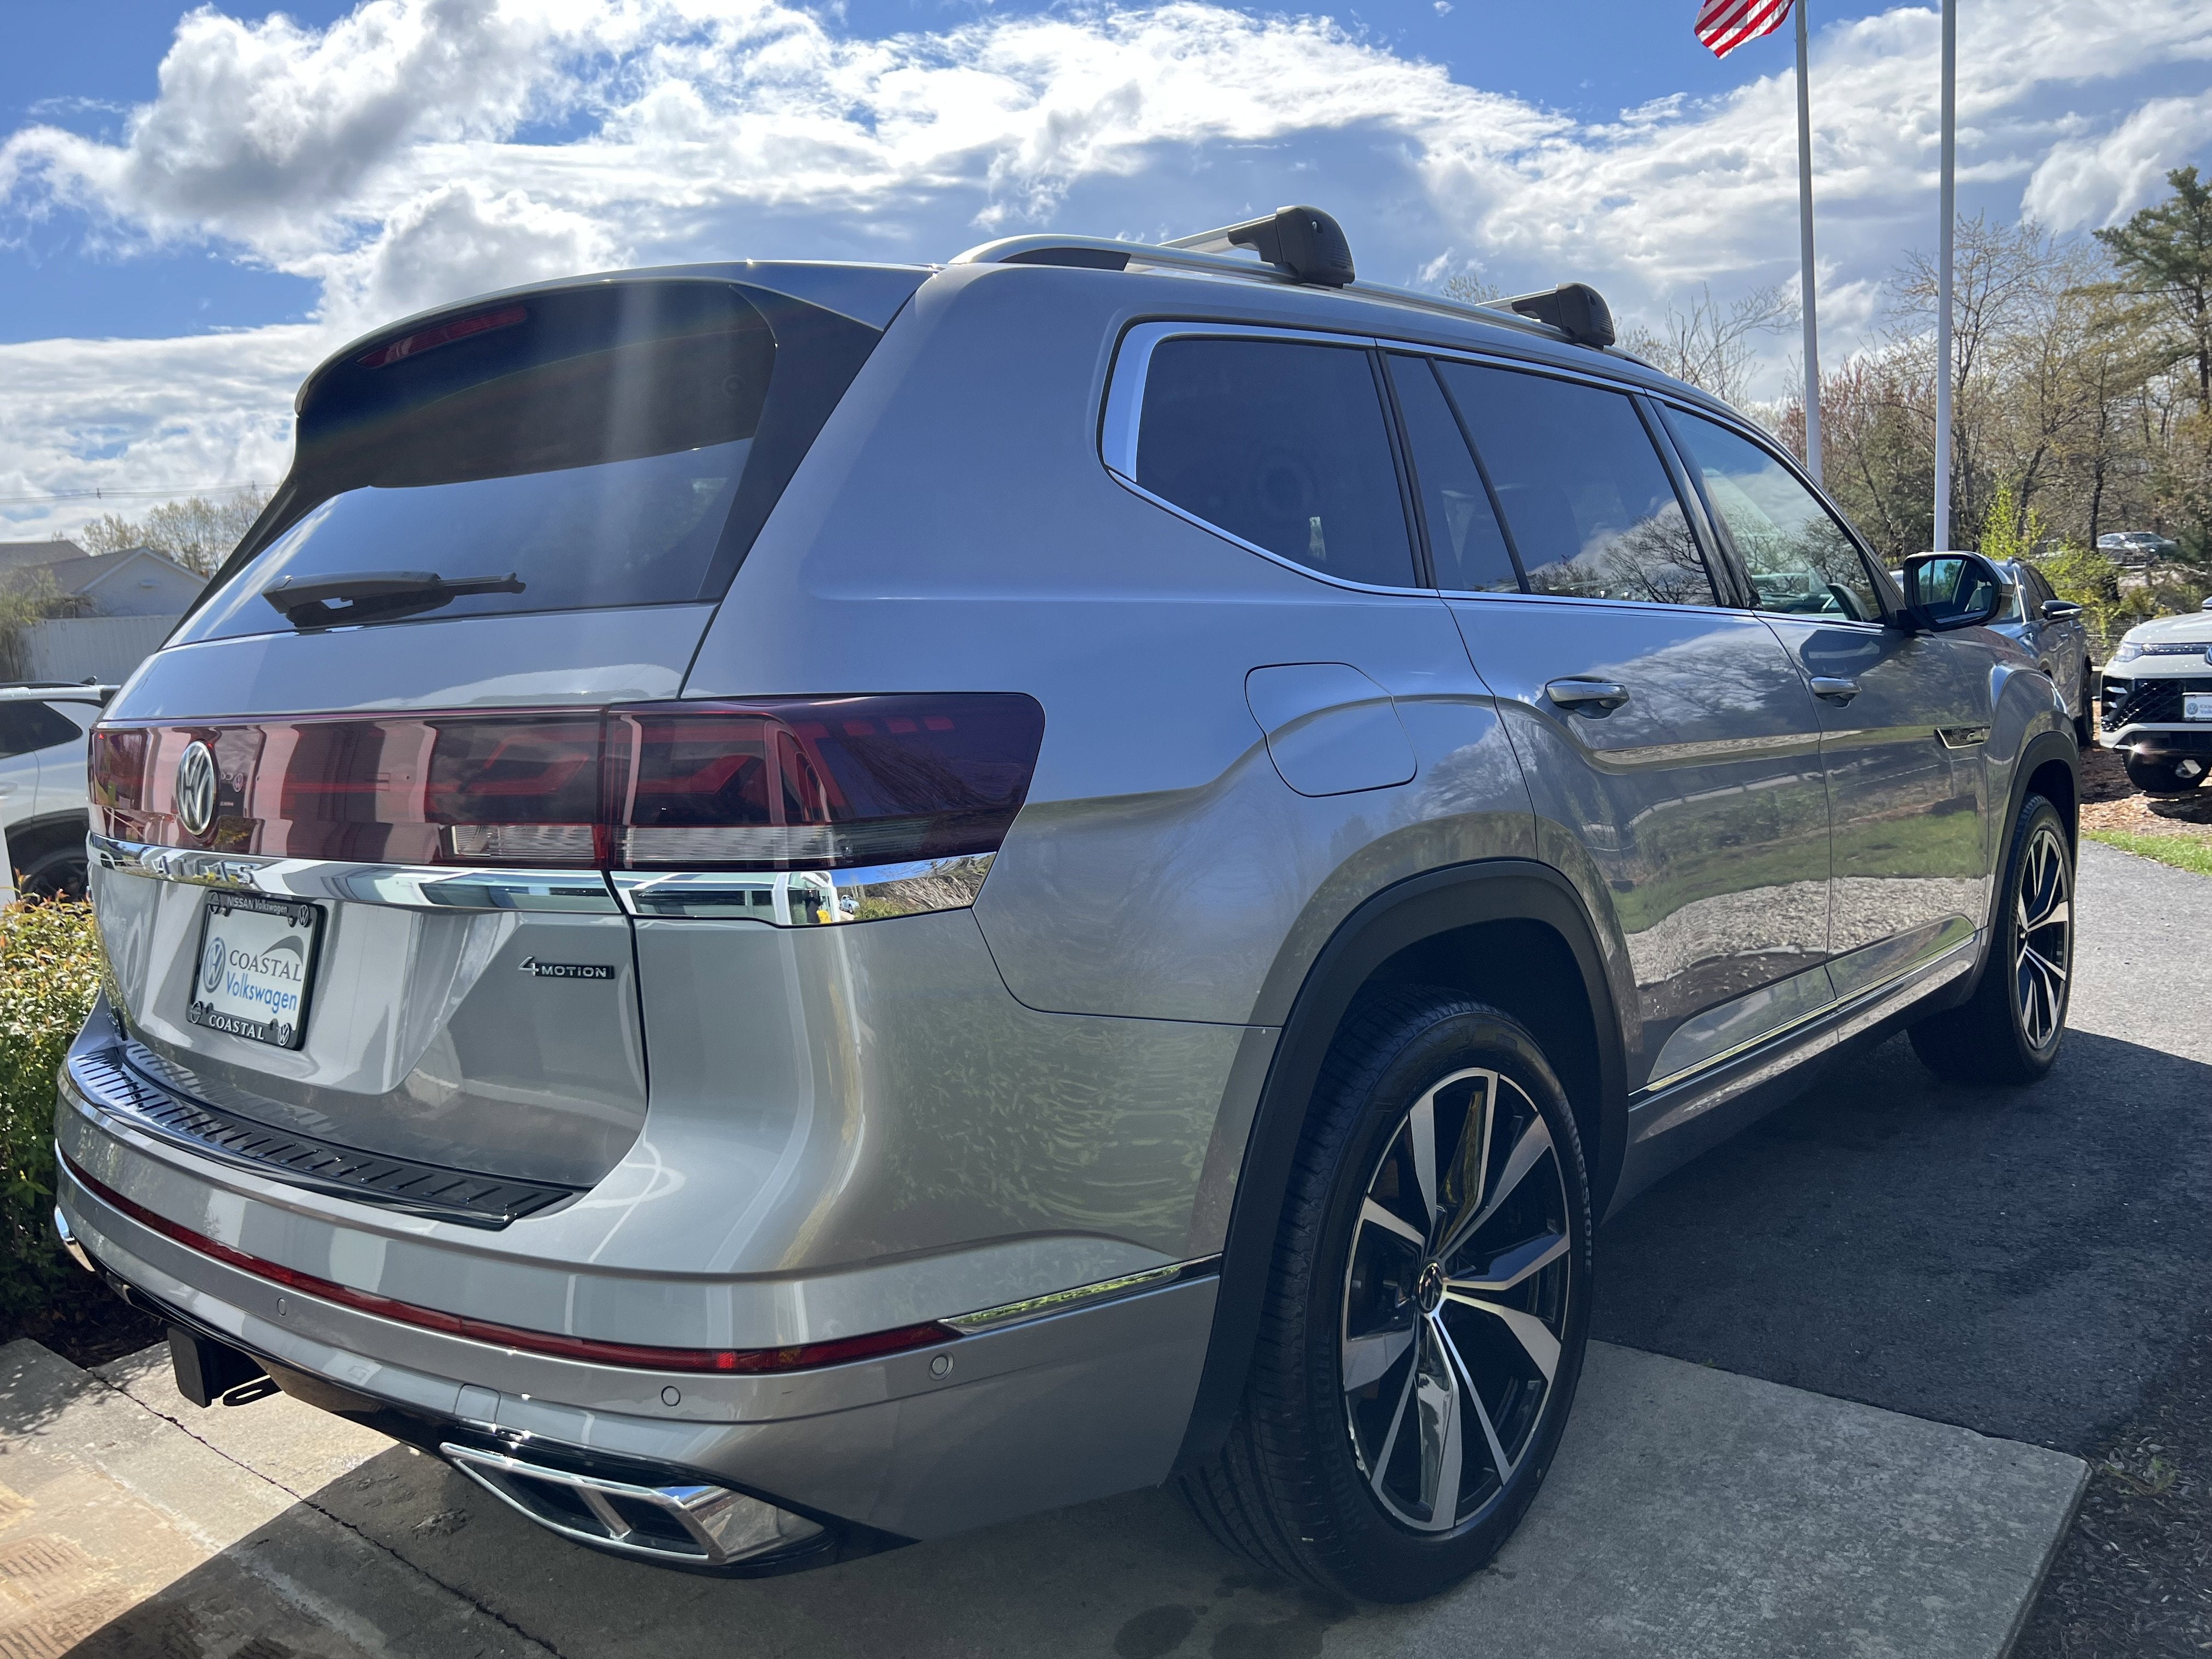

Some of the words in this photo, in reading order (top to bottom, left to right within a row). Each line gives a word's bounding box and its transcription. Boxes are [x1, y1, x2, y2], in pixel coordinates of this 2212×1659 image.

[151, 855, 254, 884] ATLAS
[228, 896, 253, 909] NISSAN
[255, 898, 288, 915] Volkswagen
[229, 950, 302, 982] COASTAL
[226, 971, 298, 1014] Volkswagen
[208, 1014, 264, 1040] COASTAL
